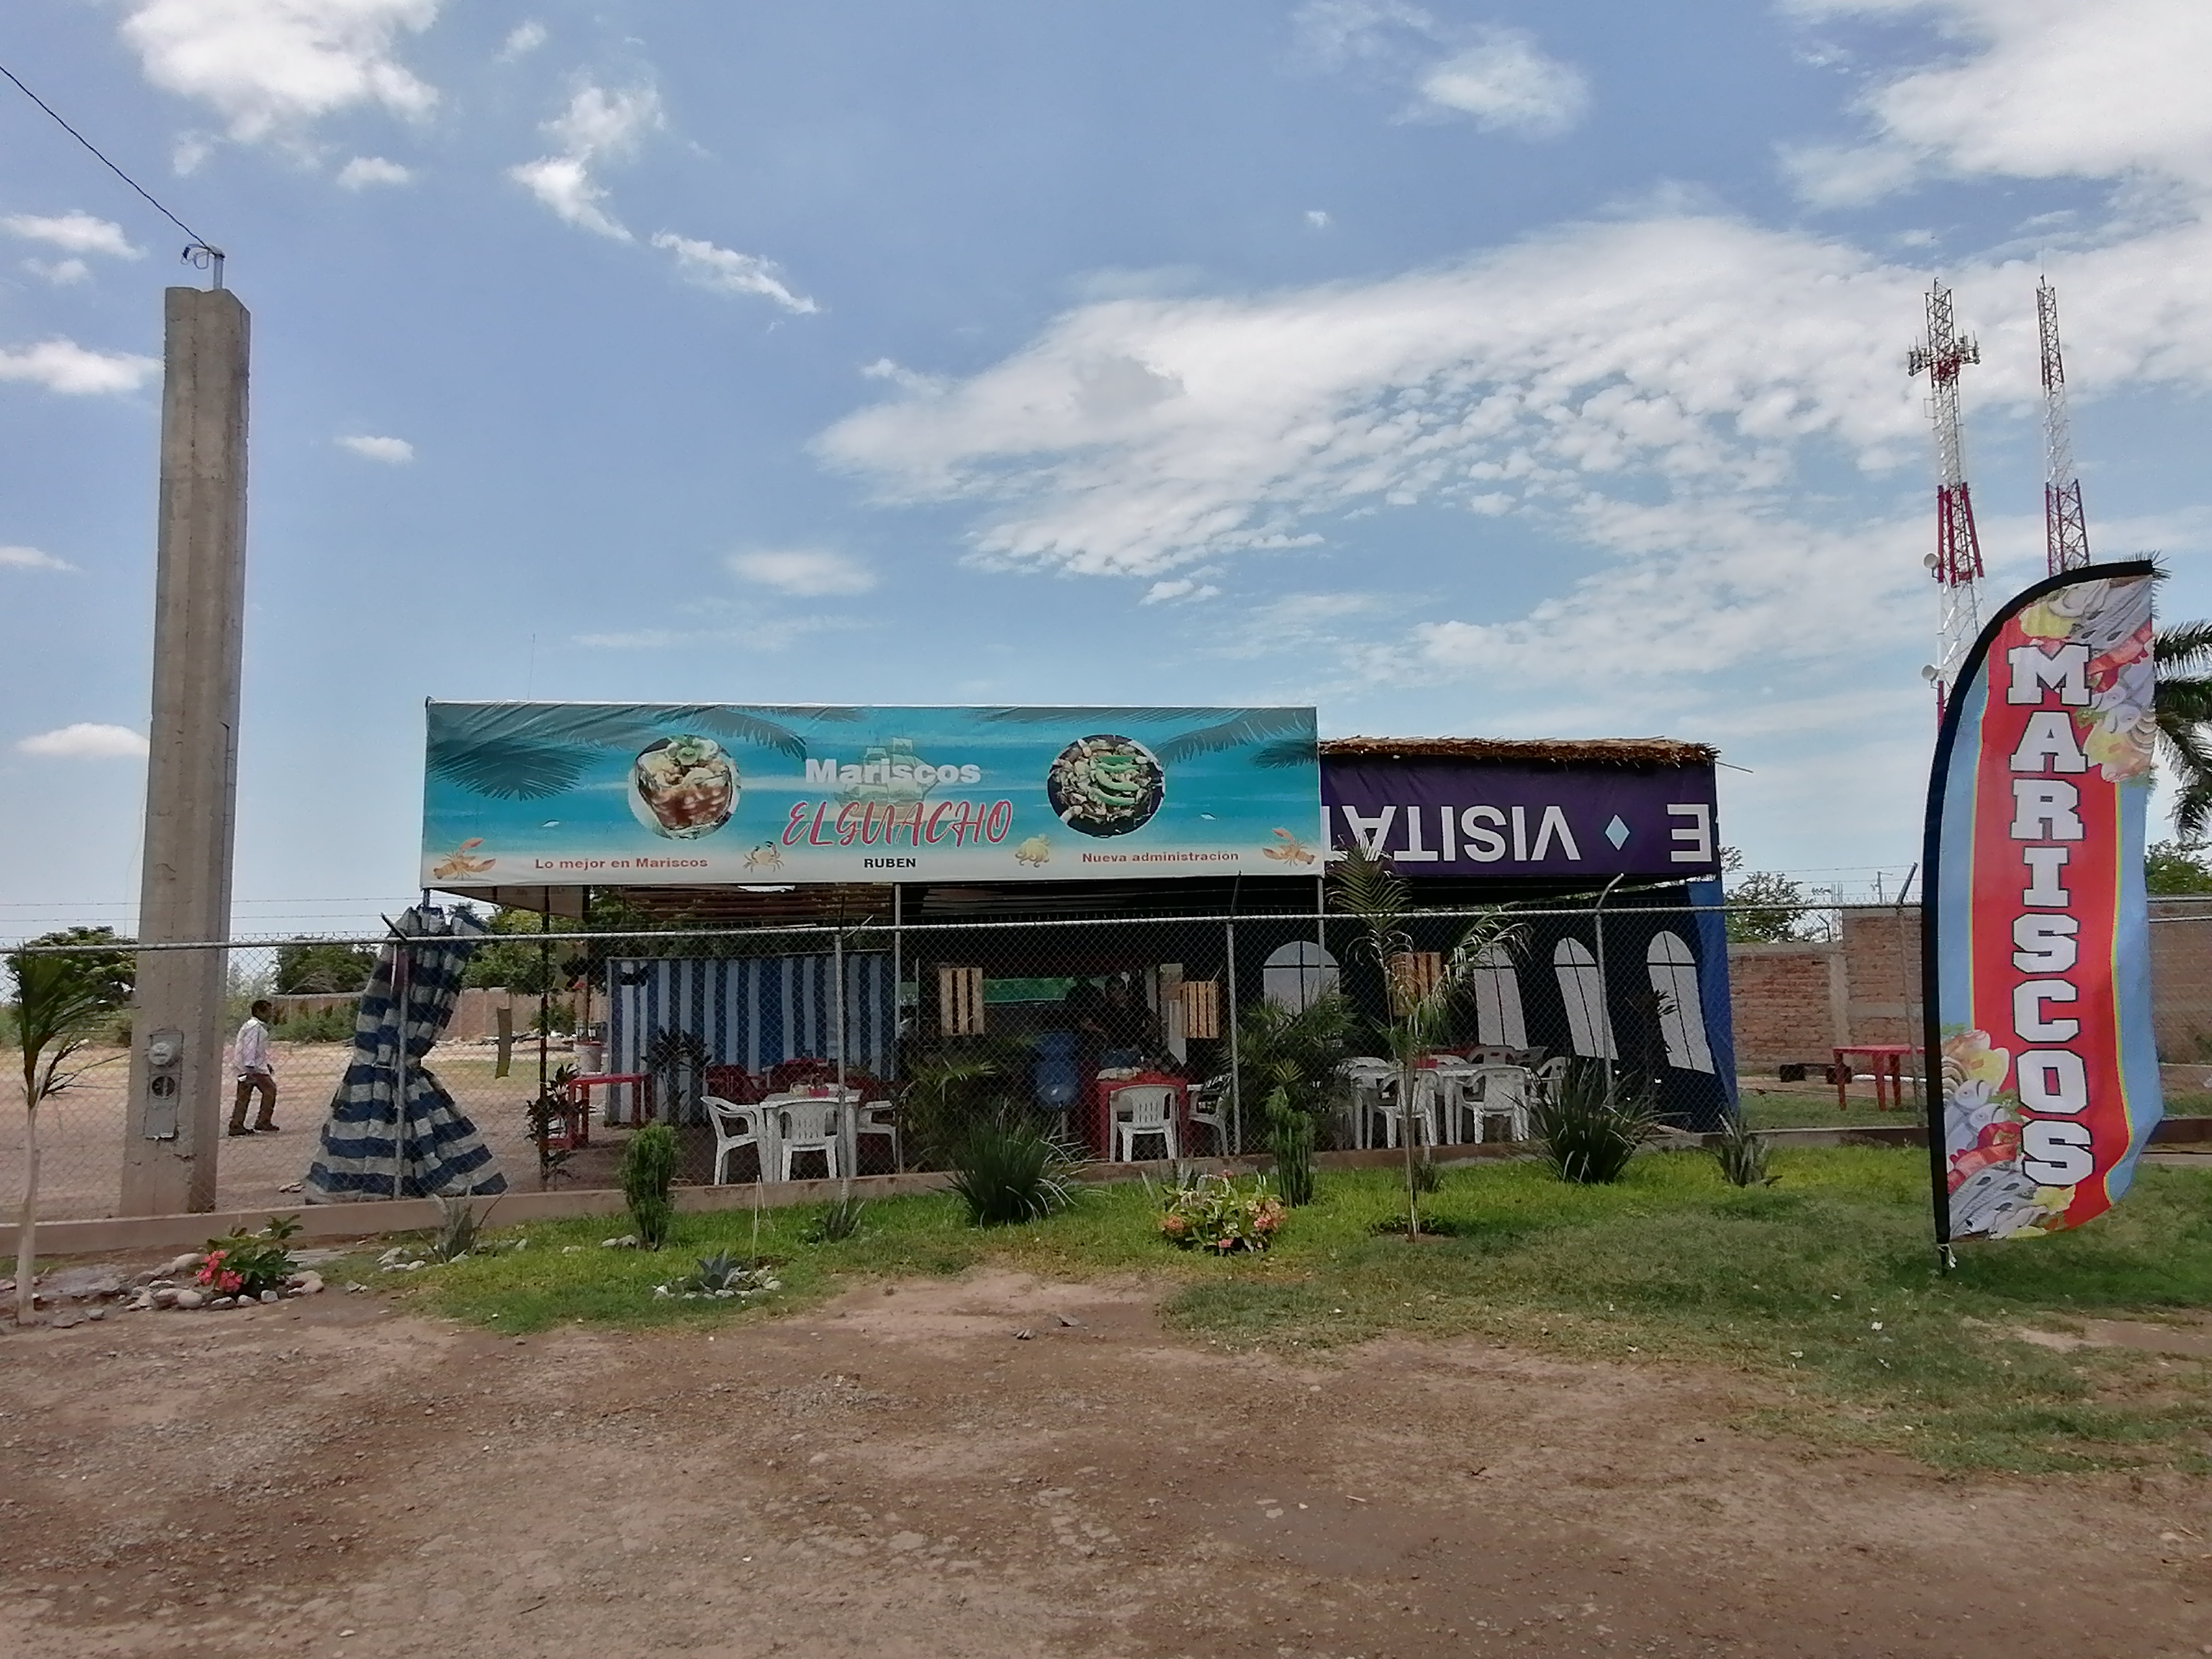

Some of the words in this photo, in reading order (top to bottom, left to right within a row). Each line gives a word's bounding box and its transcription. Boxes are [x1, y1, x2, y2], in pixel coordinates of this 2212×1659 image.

[805, 758, 981, 784] Mariscos
[535, 858, 554, 869] Lo
[559, 858, 606, 871] mejor
[611, 859, 630, 868] en
[636, 857, 708, 868] Mariscos
[864, 858, 917, 868] RUBEN
[1082, 853, 1127, 863] Nueva
[1132, 851, 1240, 862] administración
[2007, 642, 2093, 1187] MARISCOS
